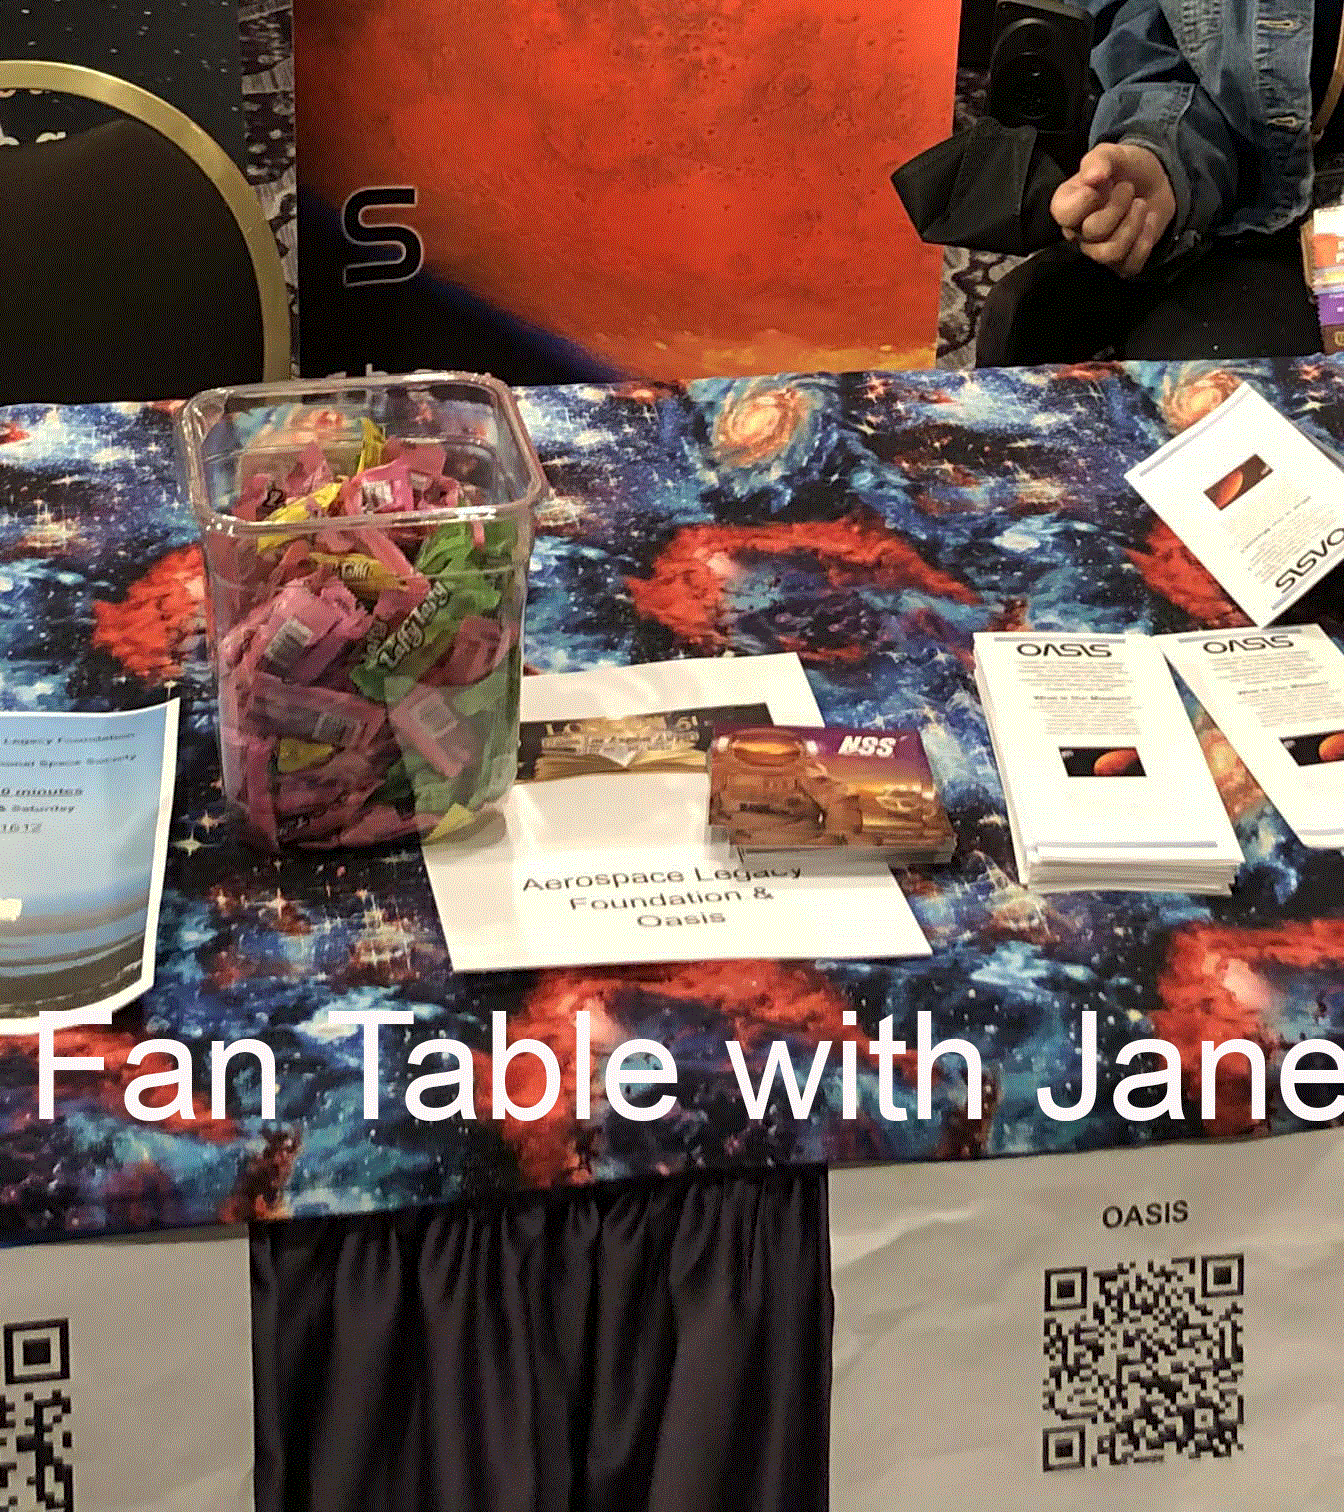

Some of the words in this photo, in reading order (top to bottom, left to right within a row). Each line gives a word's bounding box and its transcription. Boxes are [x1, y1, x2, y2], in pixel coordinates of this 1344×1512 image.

[838, 735, 897, 758] NSS
[523, 867, 685, 892] Aerospace
[569, 886, 742, 910] Foundation
[753, 885, 774, 901] &
[636, 910, 727, 929] Oasis
[1101, 1199, 1190, 1230] OASIS
